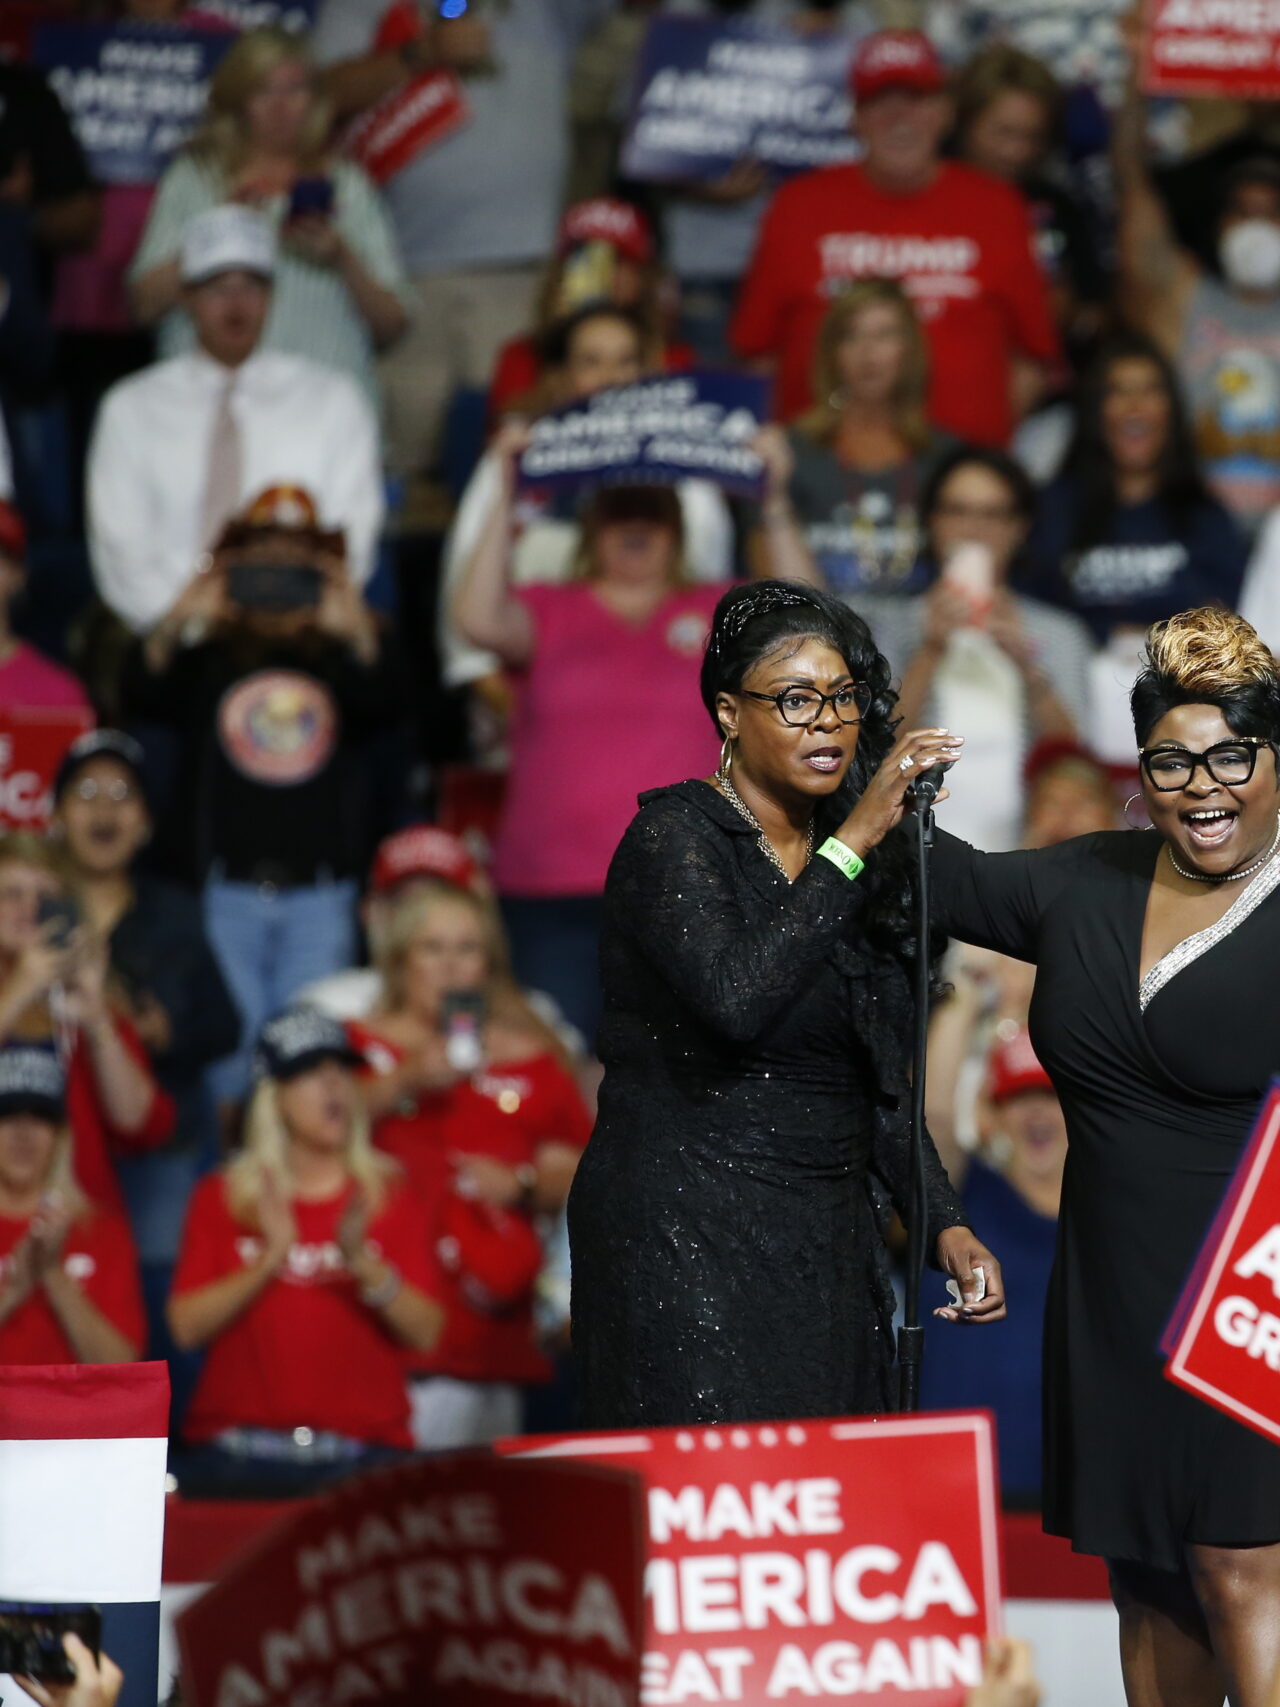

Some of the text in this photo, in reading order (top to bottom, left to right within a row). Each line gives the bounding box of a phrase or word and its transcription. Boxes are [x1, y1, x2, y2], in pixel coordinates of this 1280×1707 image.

[1152, 35, 1272, 69] GREAT
[818, 232, 981, 276] TRUMP
[526, 402, 758, 446] AMERICA
[297, 1494, 501, 1590] MAKE
[646, 1477, 844, 1544] MAKE
[643, 1541, 979, 1635] ERICA
[216, 1555, 632, 1707] AMERICA
[640, 1633, 984, 1707] EAT AGAIN
